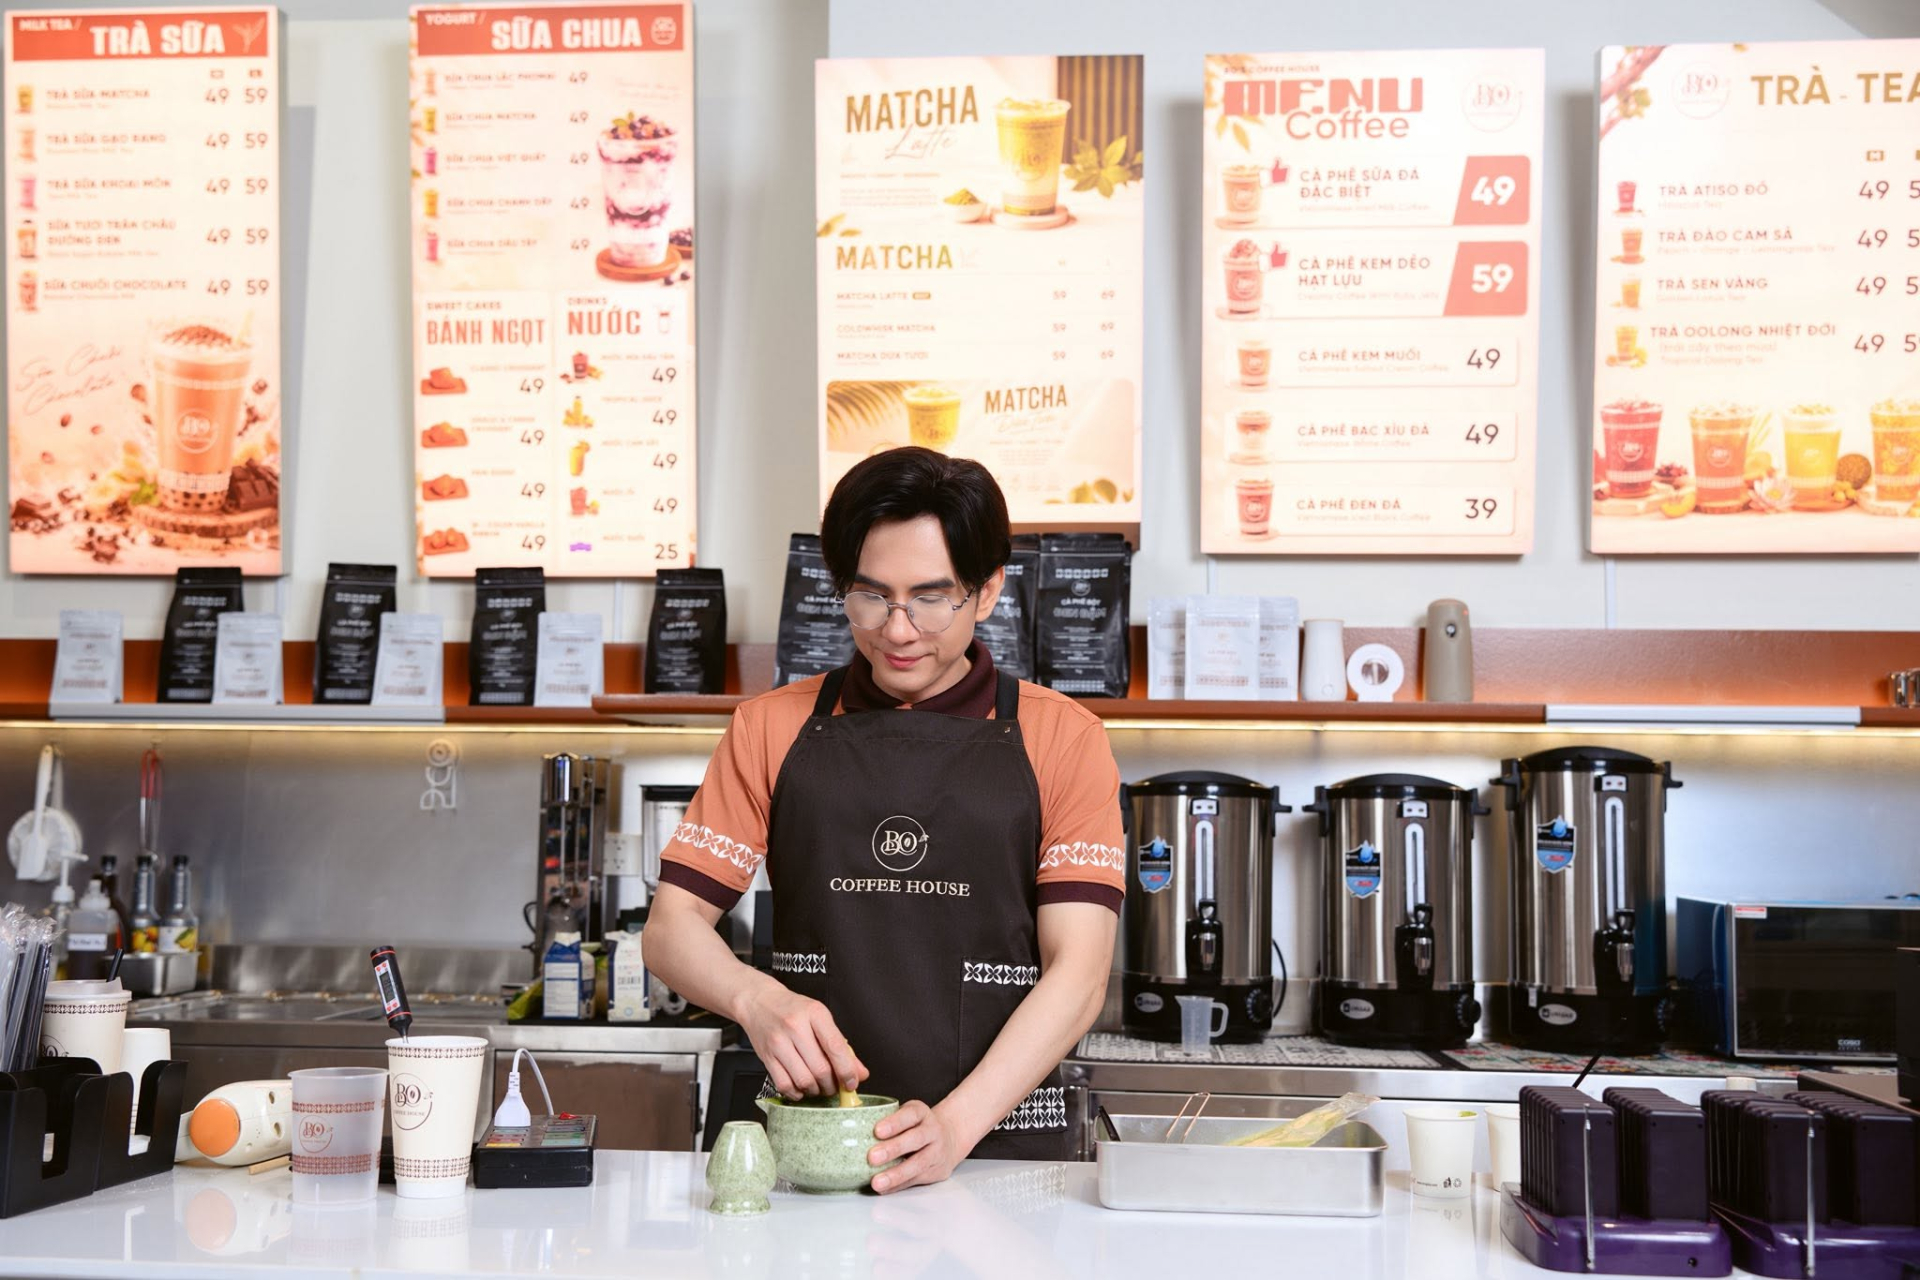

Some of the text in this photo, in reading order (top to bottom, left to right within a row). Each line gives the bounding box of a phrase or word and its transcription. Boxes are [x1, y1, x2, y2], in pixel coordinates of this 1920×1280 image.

[19, 19, 72, 31] MILK TEA
[425, 13, 477, 25] YOGURT
[90, 20, 226, 55] TRÀ SỮA
[491, 16, 643, 50] SỮA CHUA
[569, 71, 589, 84] 49
[1750, 66, 1831, 105] TRÀ
[205, 87, 268, 103] 49 59
[1224, 77, 1424, 115] MENU
[569, 111, 589, 124] 49
[846, 85, 979, 134] MATCHA
[1286, 109, 1410, 139] Coffee
[205, 132, 269, 148] 49 59
[570, 152, 589, 165] 49
[1300, 169, 1320, 182] CÀ
[1328, 167, 1358, 182] PHÊ
[1362, 166, 1392, 181] SỮA
[205, 178, 269, 194] 49 59
[1471, 177, 1516, 206] 49
[1660, 184, 1687, 196] TRÀ
[1693, 184, 1739, 196] ATISO
[1859, 180, 1889, 199] 49
[570, 196, 589, 209] 49
[206, 228, 270, 244] 49 59
[1658, 230, 1686, 242] TRÀ
[1733, 231, 1768, 241] CAM
[1858, 229, 1888, 248] 49
[570, 238, 590, 251] 49
[836, 244, 953, 270] MATCHA
[1299, 257, 1320, 270] CÀ
[1326, 256, 1355, 270] PHÊ
[1360, 257, 1392, 269] KEM
[1471, 263, 1514, 293] 59
[1657, 278, 1685, 290] TRÀ
[1692, 279, 1719, 290] SEN
[1856, 276, 1887, 295] 49
[207, 279, 270, 296] 49 59
[567, 306, 641, 336] NƯỚC
[427, 316, 545, 346] BÁNH NGỌT
[1651, 325, 1679, 337] TRÀ
[1685, 325, 1752, 337] OOLONG
[1854, 334, 1884, 353] 49
[1299, 350, 1319, 361] CÀ
[1323, 348, 1348, 361] PHÊ
[1352, 350, 1380, 361] KEM
[1467, 348, 1501, 369] 49
[652, 367, 677, 383] 49
[520, 378, 544, 393] 49
[985, 384, 1068, 414] MATCHA
[653, 410, 677, 425] 49
[520, 430, 545, 445] 49
[1298, 424, 1318, 436] CÀ
[1466, 424, 1499, 445] 49
[653, 453, 678, 469] 49
[521, 483, 545, 498] 49
[653, 498, 678, 513] 49
[1297, 499, 1315, 510] CÀ
[1466, 498, 1497, 519] 39
[522, 535, 546, 550] 49
[655, 544, 679, 560] 25
[880, 830, 918, 856] BO
[830, 877, 970, 897] COFFEE HOUSE
[394, 1083, 422, 1107] BO
[302, 1121, 326, 1139] BO
